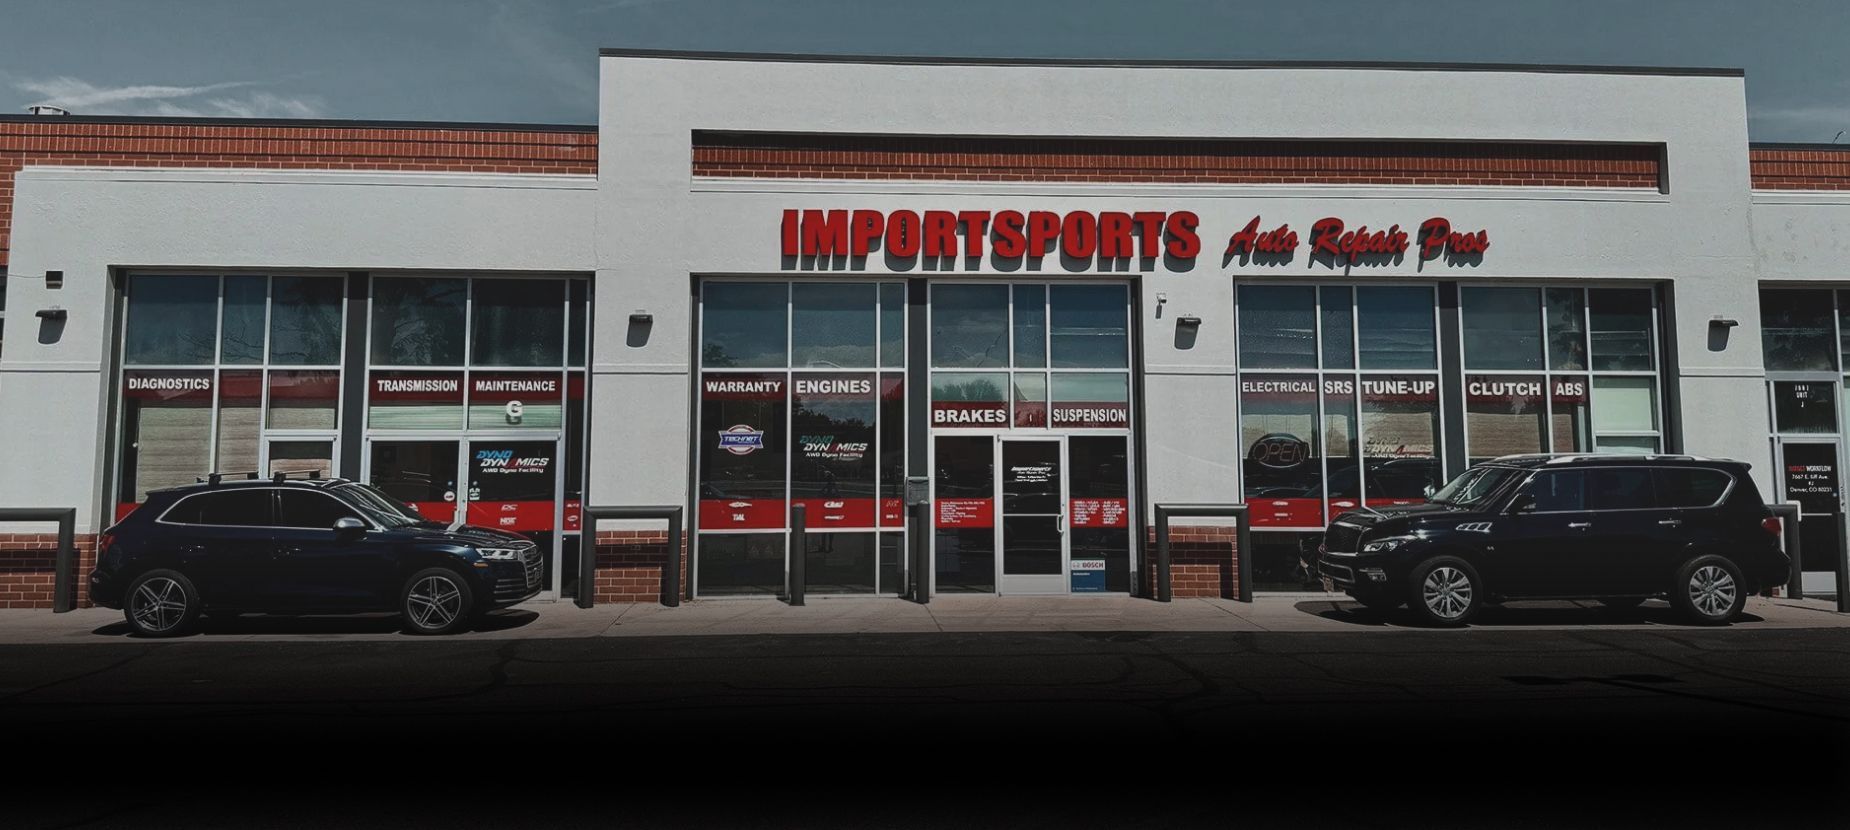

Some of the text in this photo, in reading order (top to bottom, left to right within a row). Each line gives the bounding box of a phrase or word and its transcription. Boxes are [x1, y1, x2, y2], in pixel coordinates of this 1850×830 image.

[781, 210, 1201, 258] IMPORTSPORTS
[1230, 215, 1489, 259] Auto Repair Pros
[128, 378, 211, 391] DIAGNOSTICS
[377, 379, 458, 392] TRANSMISSION
[475, 380, 556, 391] MAINTENANCE
[705, 380, 781, 393] WARRANTY
[796, 379, 871, 394] ENGINES
[1242, 381, 1316, 394] ELECTRICAL
[1324, 380, 1353, 394] SRS
[1362, 380, 1435, 395] TUNE-UP
[1469, 382, 1541, 396] CLUTCH
[1555, 382, 1583, 396] ABS
[934, 408, 1006, 423] BRAKES
[1052, 407, 1125, 423] SUSPENSION
[803, 443, 868, 451] DYNAMICS
[1252, 441, 1308, 463] OPEN
[475, 450, 513, 459] DYNO
[480, 458, 550, 467] DYNAMICS
